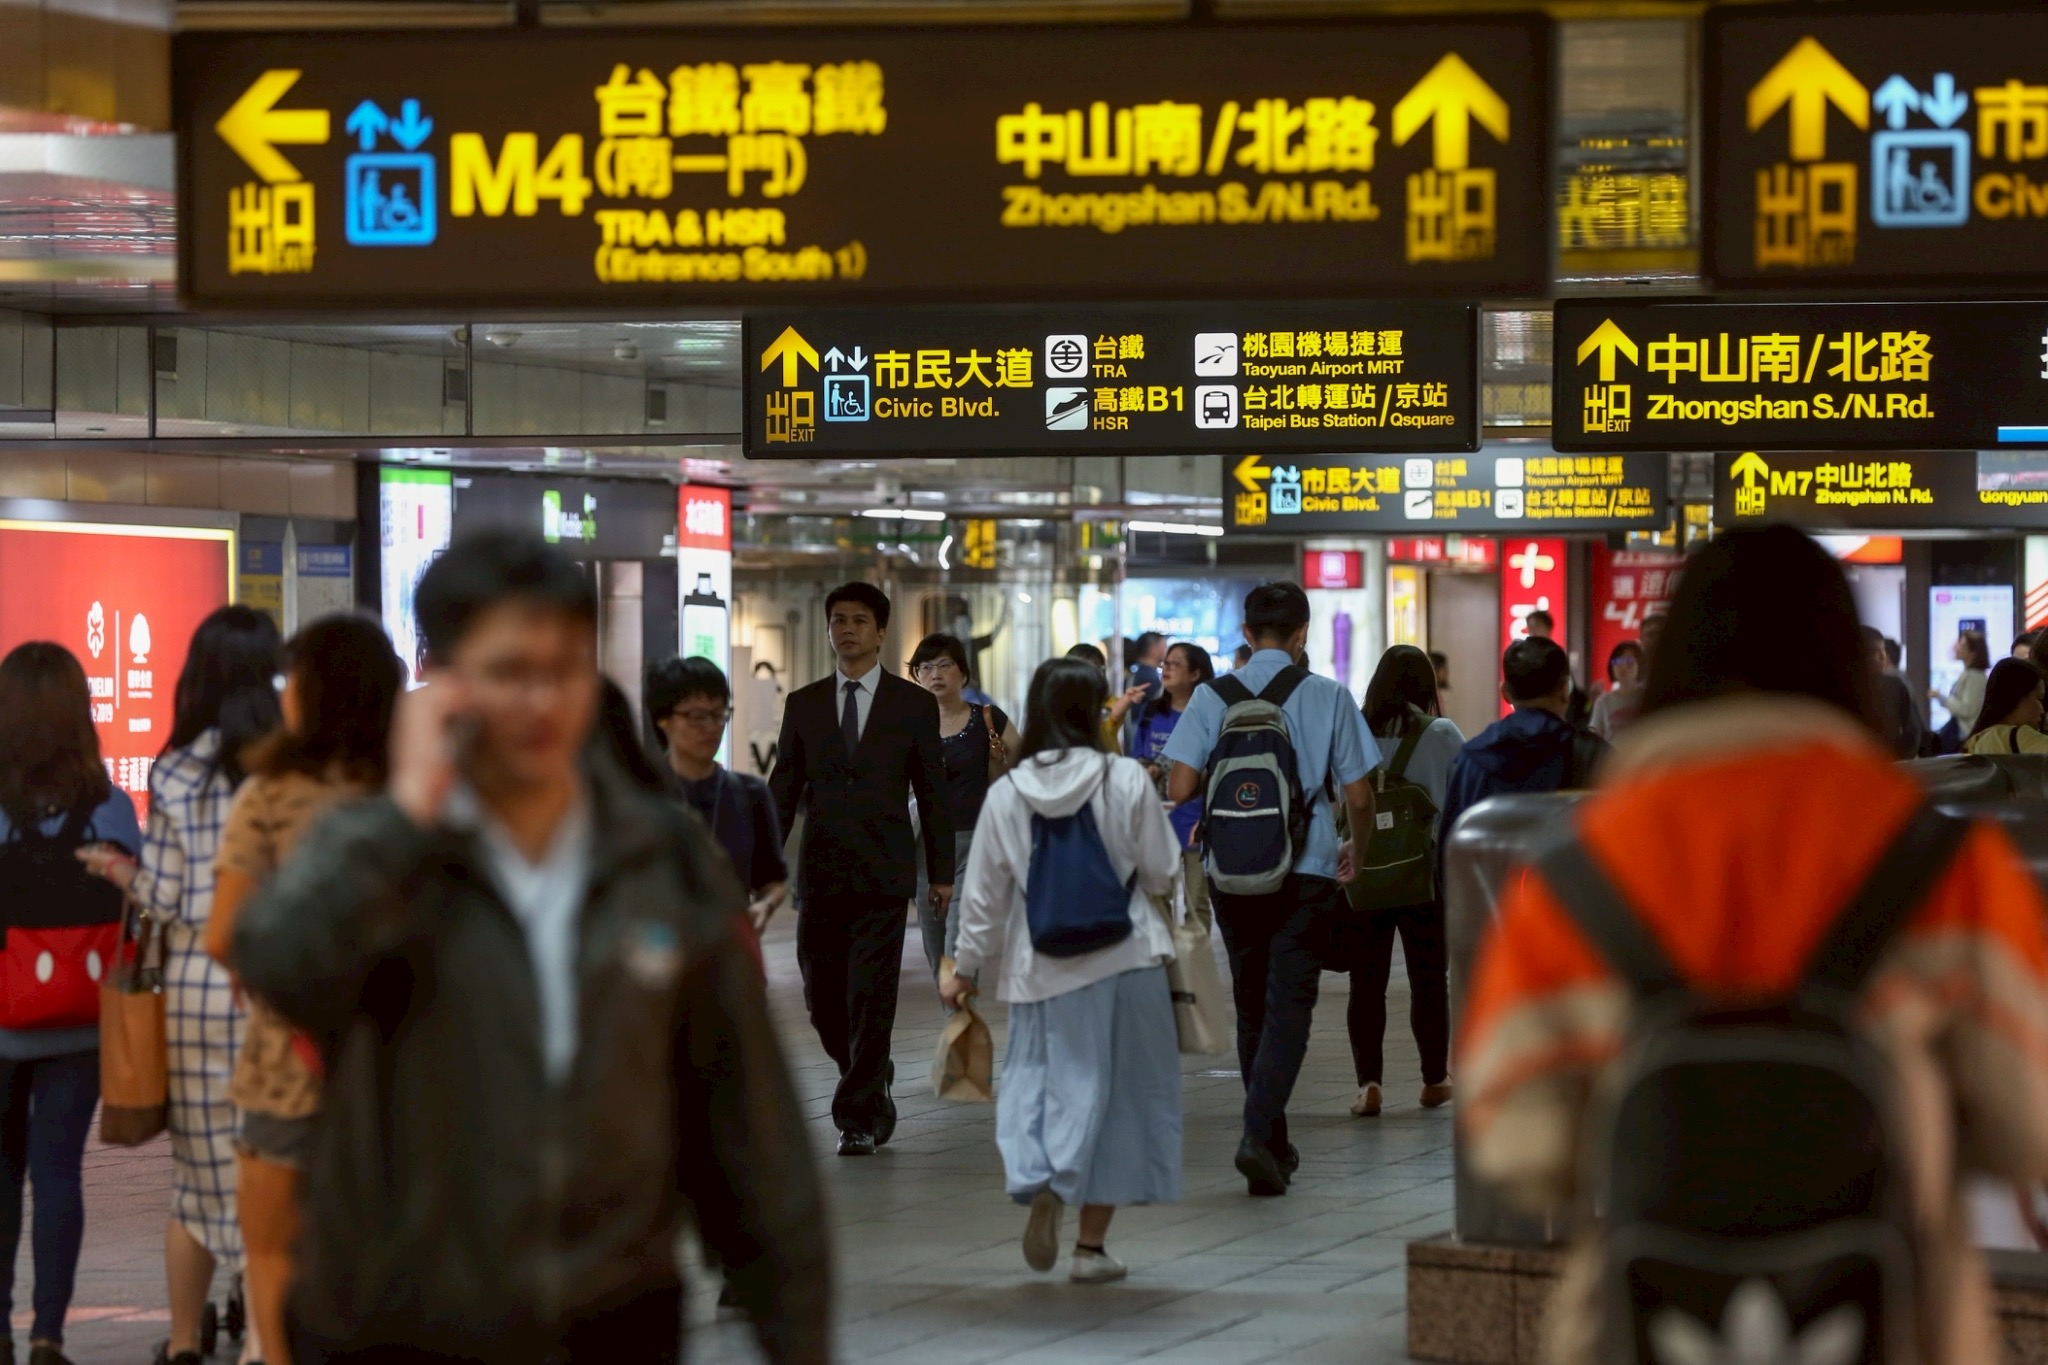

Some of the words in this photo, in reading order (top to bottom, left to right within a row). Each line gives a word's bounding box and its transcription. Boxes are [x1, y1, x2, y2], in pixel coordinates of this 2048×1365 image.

[996, 95, 1379, 178] 中山南/北路
[450, 132, 593, 217] M4
[594, 133, 807, 199] (南一門)
[1002, 184, 1218, 233] Zhongshan
[1309, 180, 1379, 221] Rd.
[1406, 164, 1496, 261] 出口
[1756, 162, 1858, 268] 出口
[229, 179, 315, 272] 出口
[593, 208, 674, 247] TRA
[1093, 333, 1145, 360] 台鐵
[1242, 329, 1403, 358] 桃園機場捷運
[1647, 330, 1933, 385] 中山南/北路
[873, 347, 1034, 390] 市民大道
[1093, 363, 1128, 378] TRA
[1242, 361, 1307, 379] Taoyuan
[1309, 361, 1364, 378] Airport
[1367, 359, 1404, 374] MRT
[873, 396, 934, 419] Civic
[940, 396, 1000, 418] Blvd.
[1093, 385, 1184, 413] 高鐵B1
[1583, 384, 1631, 433] 出口
[1646, 393, 1809, 426] Zhongshan
[1811, 392, 1884, 420] S./N.
[1885, 393, 1935, 419] Rd.
[766, 390, 815, 442] 出口
[1093, 415, 1129, 431] HSR
[1242, 414, 1287, 431] Taipei
[1289, 413, 1321, 428] Bus
[1605, 418, 1632, 433] EXIT
[788, 426, 817, 443] EXIT
[1524, 456, 1625, 475] 桃園機場捷運
[1815, 461, 1913, 488] 中山北路
[1301, 466, 1400, 494] 市民大道
[1770, 470, 1814, 496] M7
[1236, 489, 1268, 525] 出口
[1301, 495, 1341, 512] Civic
[1340, 495, 1379, 512] Blvd.
[1735, 483, 1766, 515] 出口
[1749, 505, 1766, 516] EXIT
[1815, 488, 1891, 507] Zhongshan
[1892, 489, 1908, 504] N.
[1910, 488, 1934, 504] Rd.
